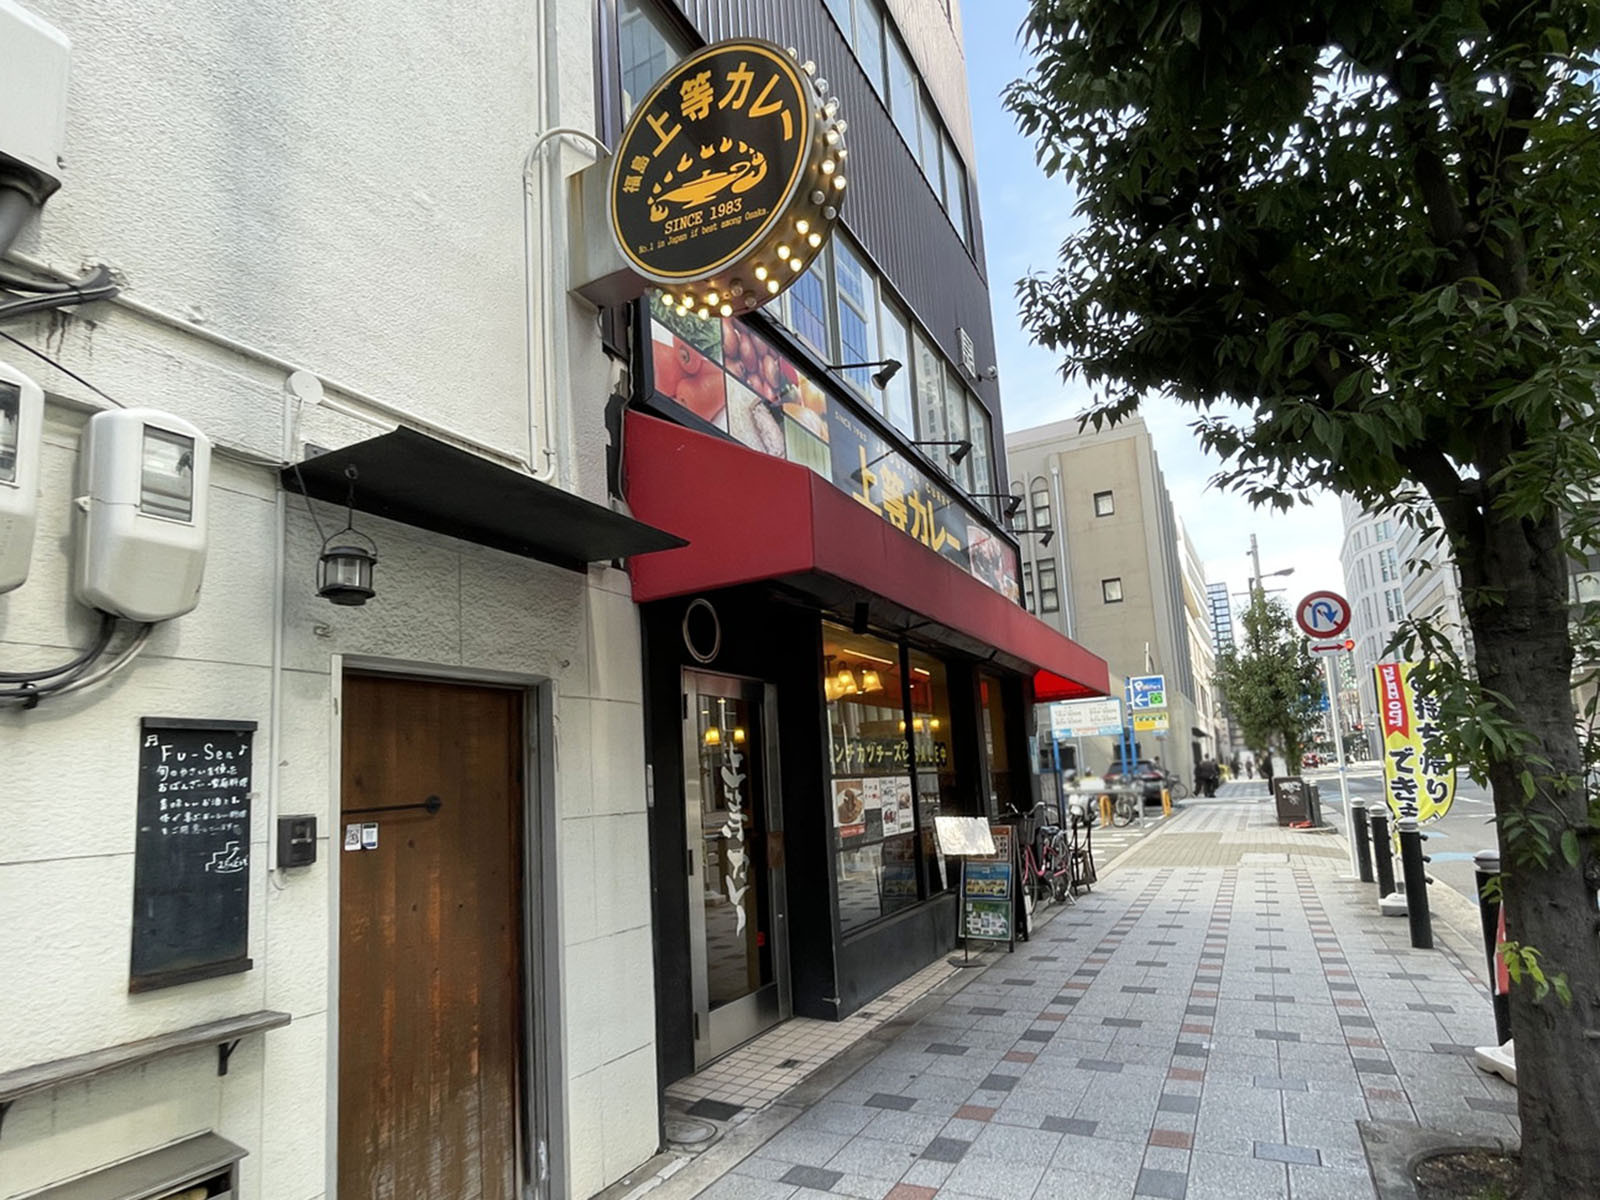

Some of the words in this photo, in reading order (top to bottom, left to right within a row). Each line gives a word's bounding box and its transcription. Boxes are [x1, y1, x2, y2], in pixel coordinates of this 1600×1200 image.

[646, 61, 794, 158] 上等カレー
[664, 210, 703, 235] SINCE
[710, 197, 743, 221] 1983
[657, 238, 666, 249] in
[667, 233, 688, 246] Japan
[702, 223, 717, 235] best
[851, 444, 962, 552] 上等カレー
[1382, 666, 1400, 700] TAKE
[1388, 701, 1403, 727] OUT
